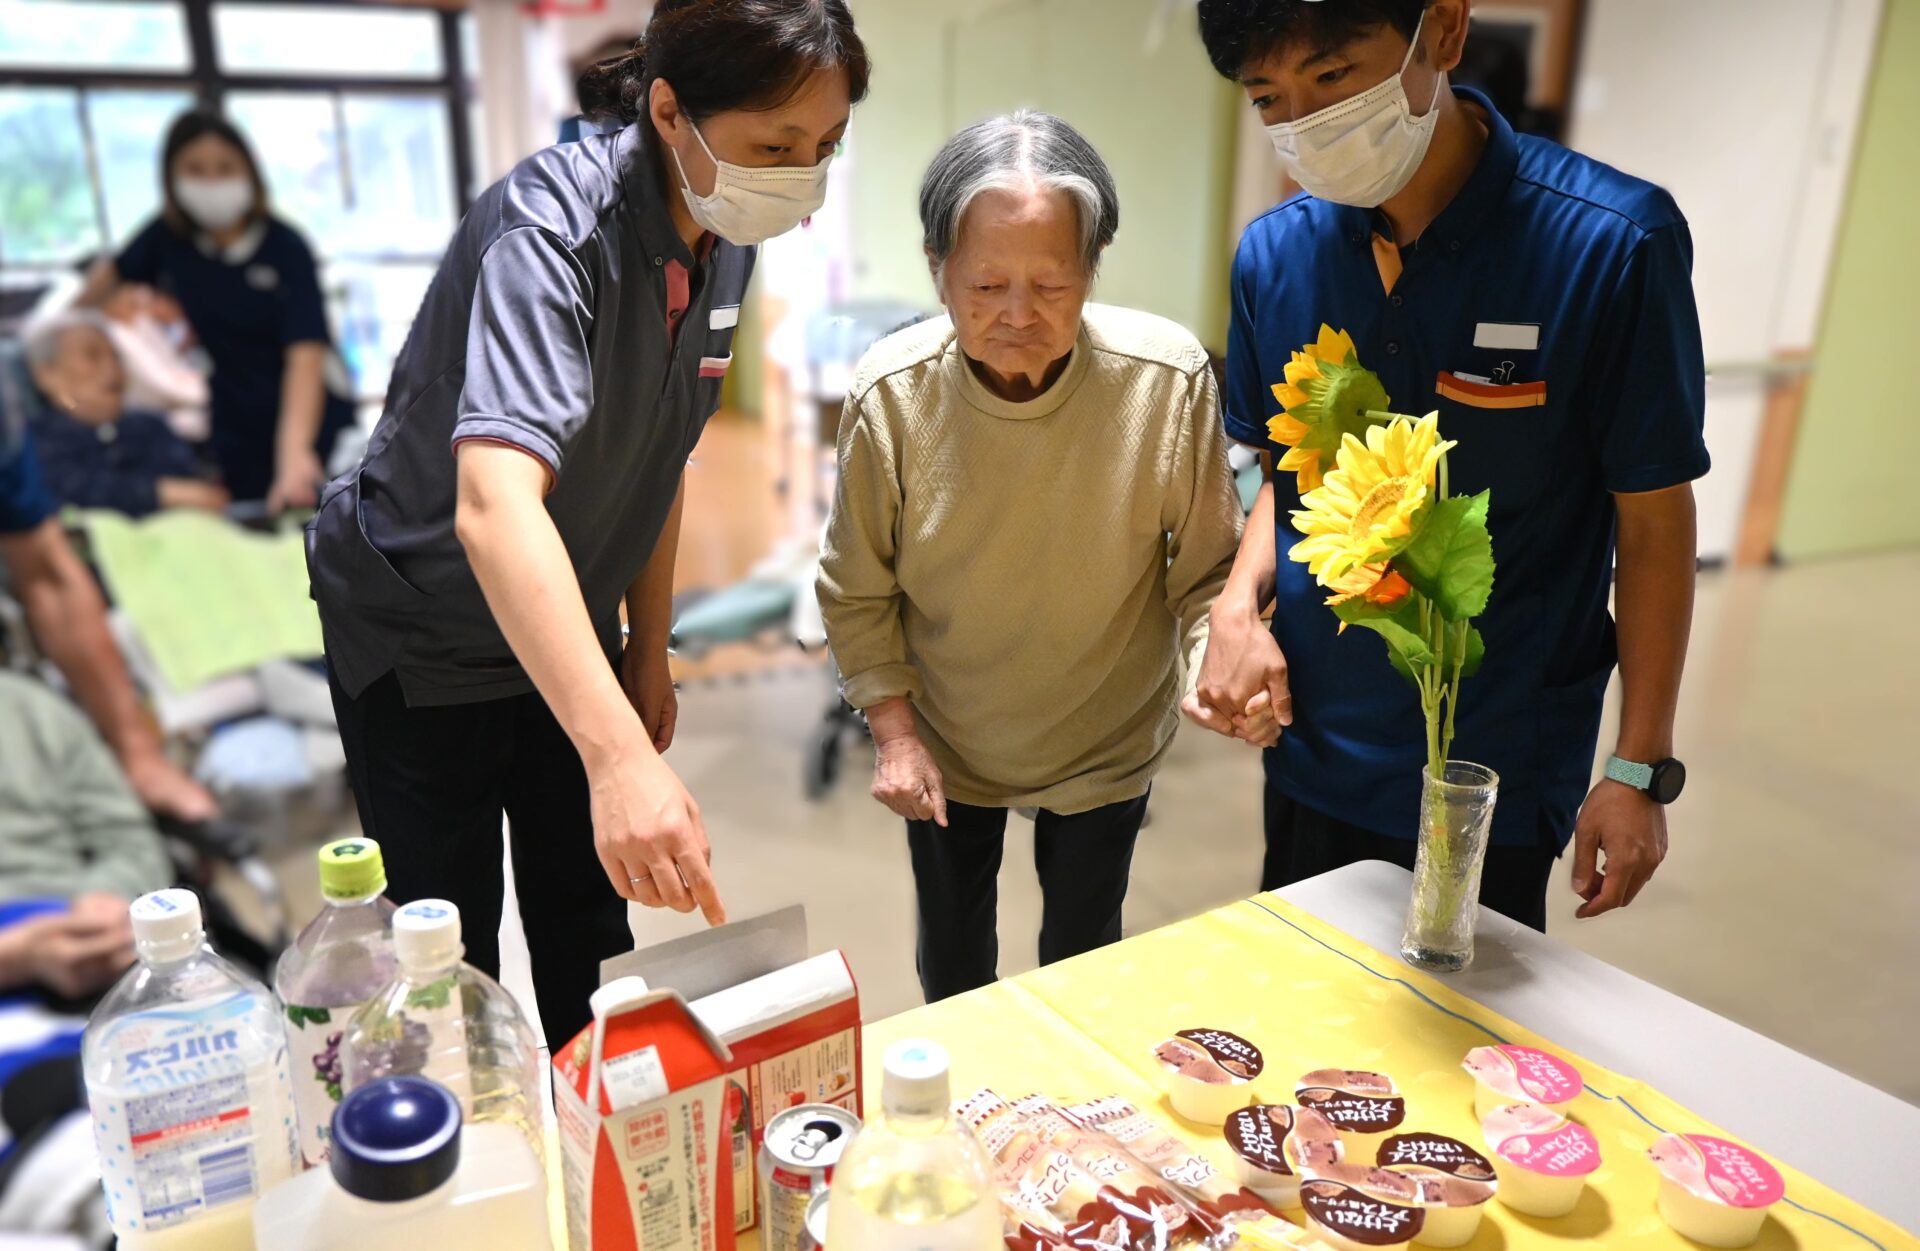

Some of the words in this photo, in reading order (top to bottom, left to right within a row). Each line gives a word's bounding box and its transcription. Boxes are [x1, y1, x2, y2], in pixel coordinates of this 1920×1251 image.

[1204, 1031, 1258, 1059] とけない
[1527, 1053, 1571, 1088] とけない
[1326, 1108, 1390, 1122] とけない
[1238, 1111, 1262, 1154] とけない
[1396, 1140, 1463, 1154] とけない
[1546, 1140, 1594, 1171] とけない
[1720, 1145, 1768, 1190] とけない
[1325, 1209, 1399, 1233] とけない
